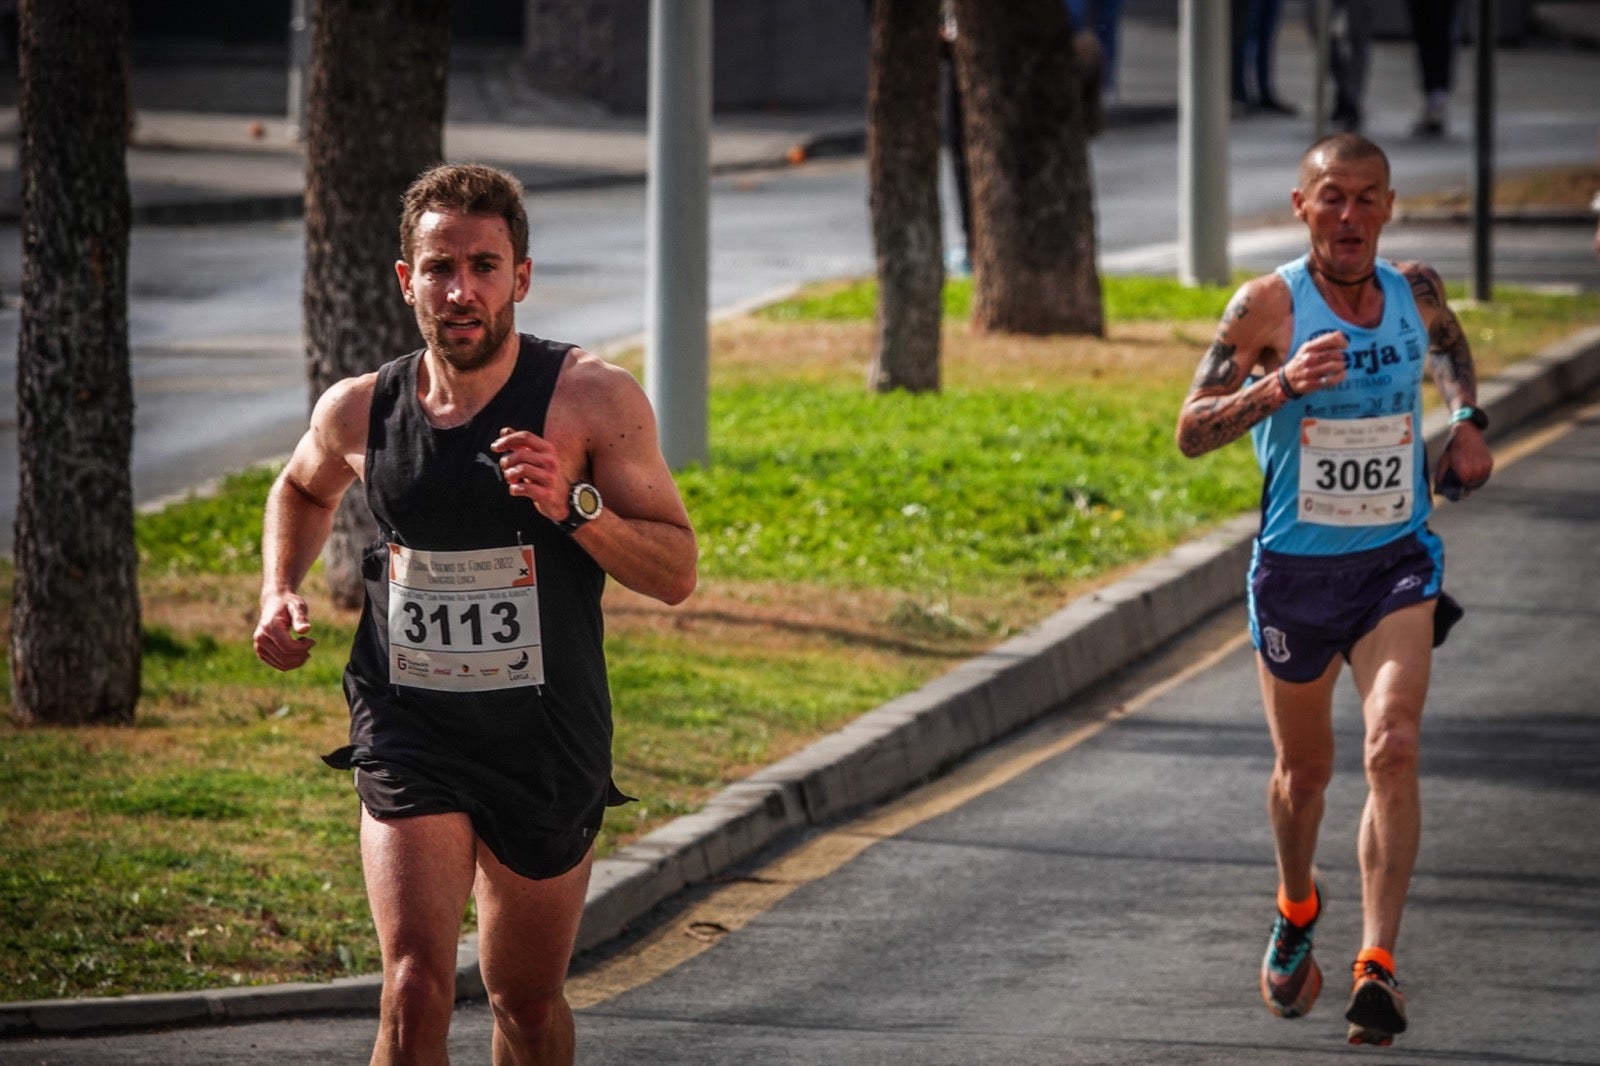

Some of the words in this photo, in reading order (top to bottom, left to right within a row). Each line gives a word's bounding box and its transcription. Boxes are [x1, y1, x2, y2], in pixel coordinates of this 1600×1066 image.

[1316, 456, 1402, 491] 3062
[468, 559, 492, 572] FONDO
[494, 556, 514, 570] 2022
[403, 601, 521, 645] 3113
